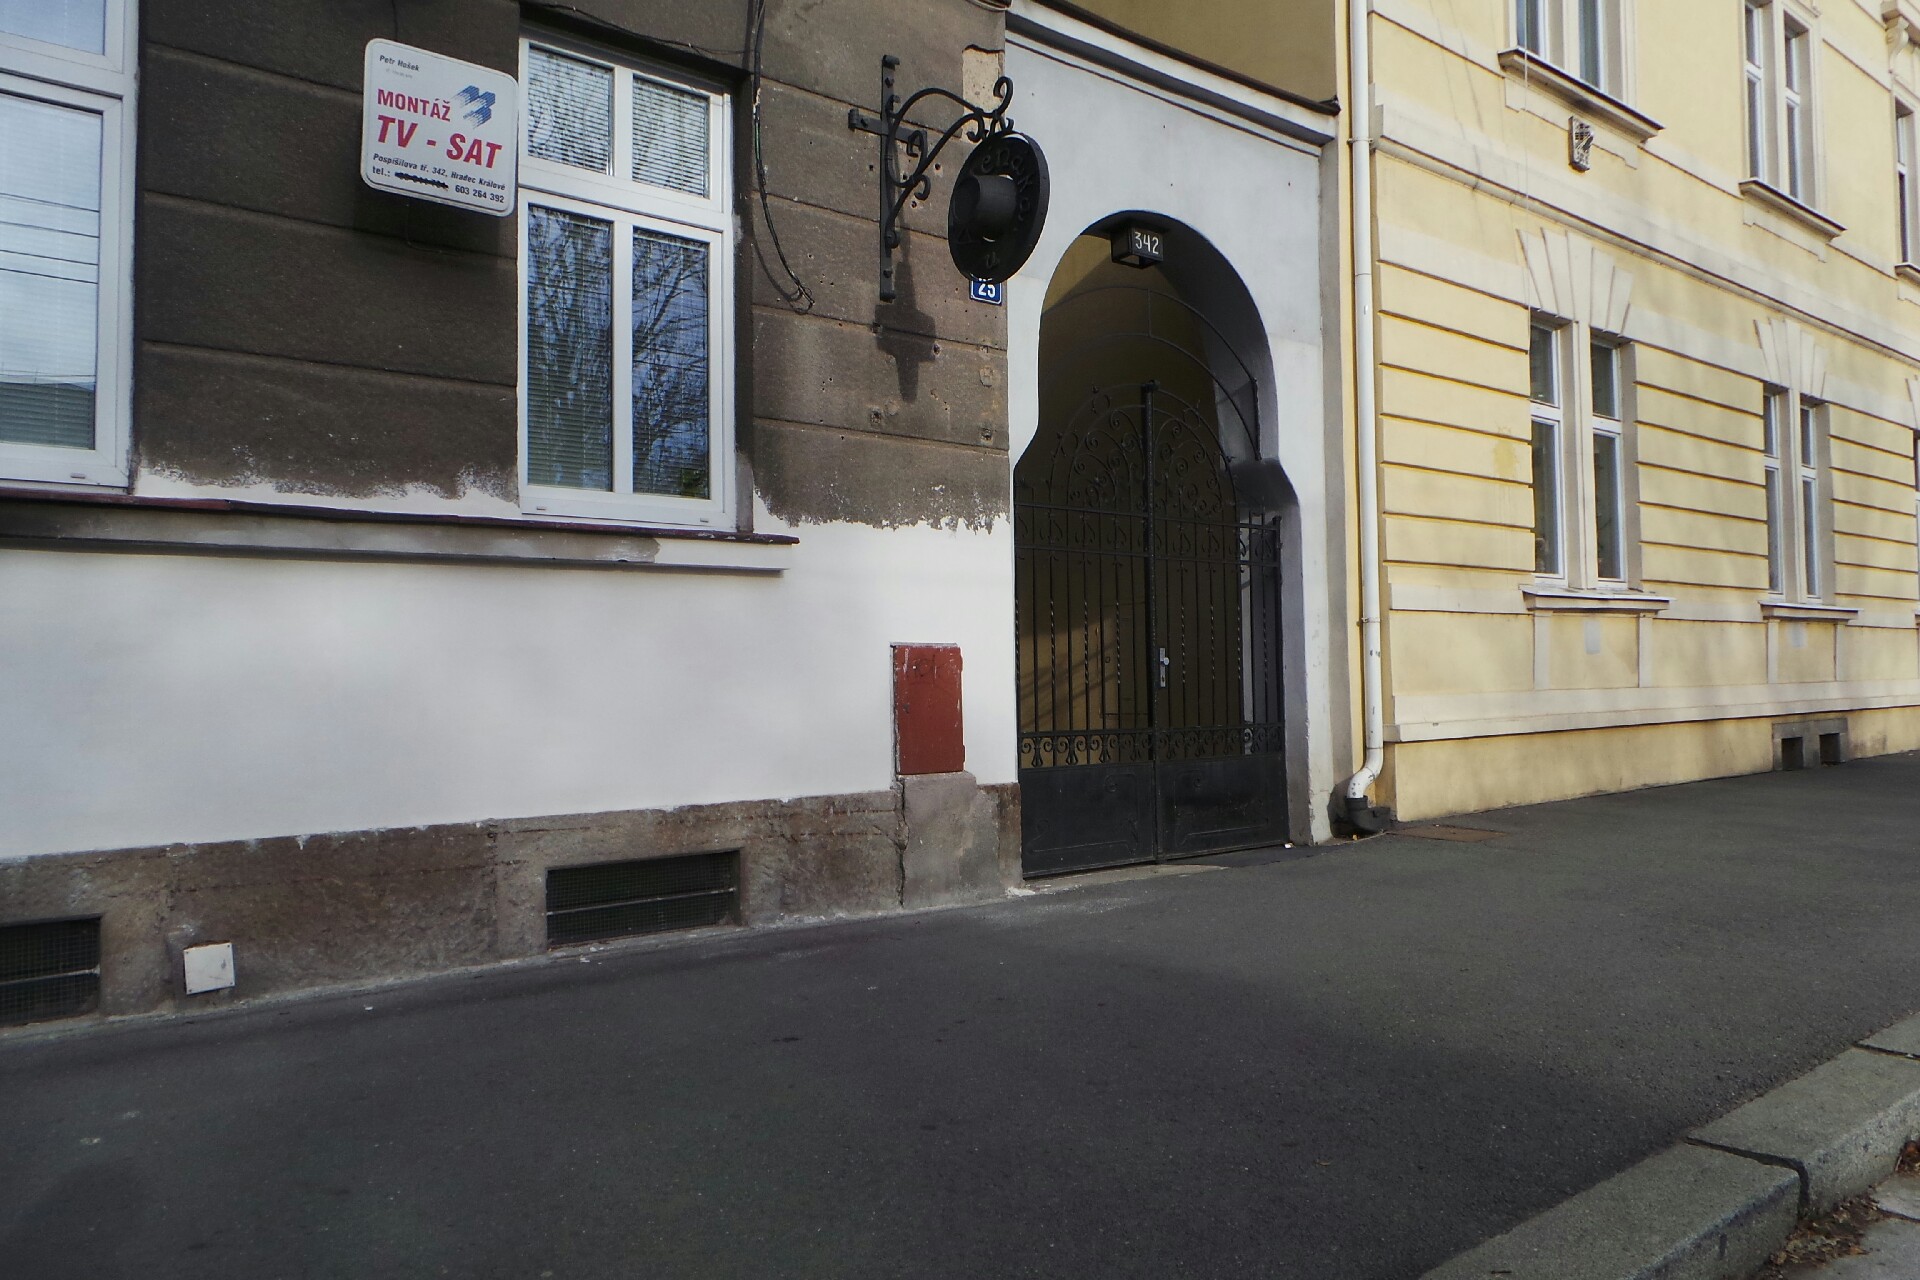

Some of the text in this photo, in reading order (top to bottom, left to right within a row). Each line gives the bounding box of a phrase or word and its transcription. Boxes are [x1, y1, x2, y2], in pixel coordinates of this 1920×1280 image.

[379, 54, 395, 64] Petr
[377, 88, 451, 122] MONTÁŽ
[377, 115, 418, 148] TV
[446, 133, 502, 168] SAT
[450, 171, 477, 184] Hradec
[478, 178, 506, 191] Králové
[455, 184, 470, 195] 603
[472, 188, 487, 199] 264
[489, 192, 505, 204] 392
[1134, 231, 1159, 255] 342
[978, 277, 996, 298] 25
